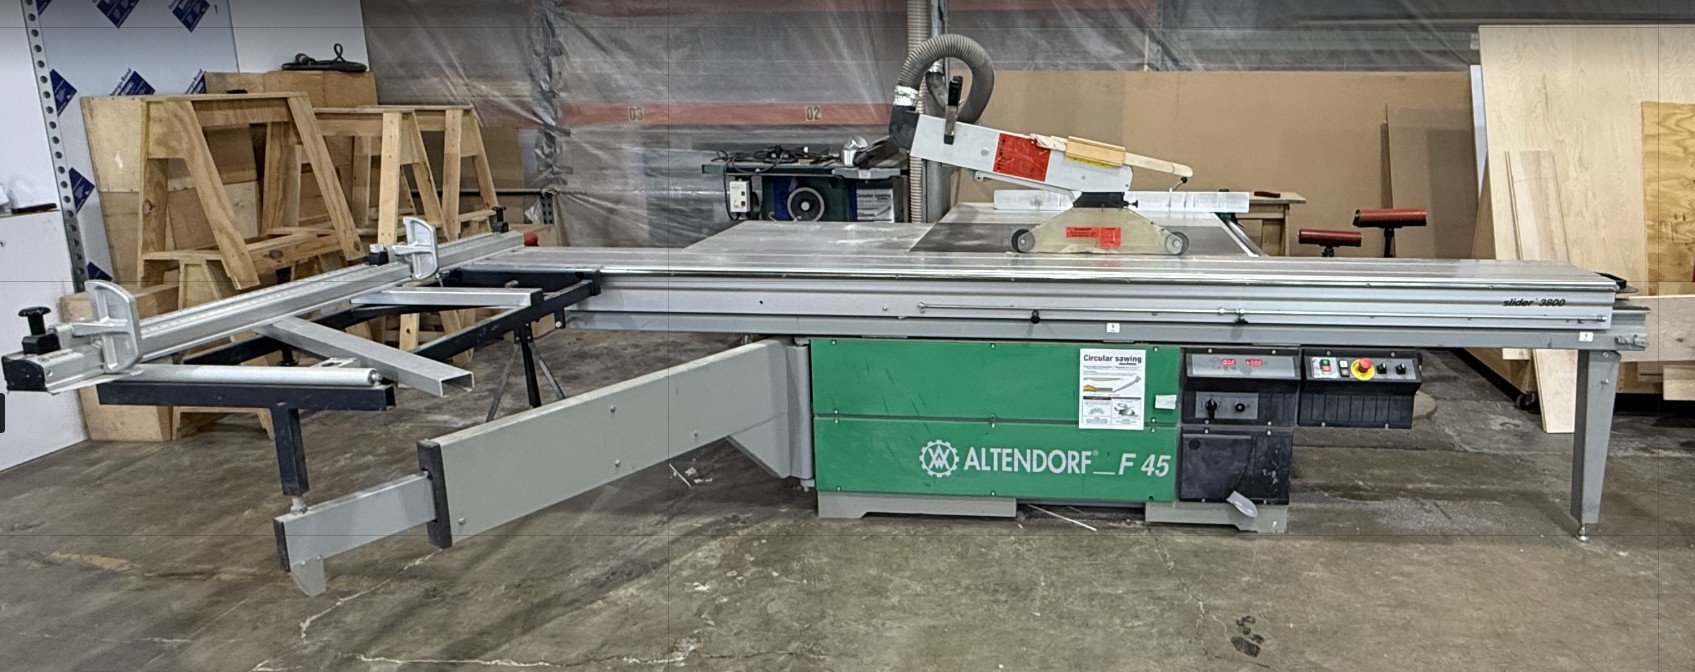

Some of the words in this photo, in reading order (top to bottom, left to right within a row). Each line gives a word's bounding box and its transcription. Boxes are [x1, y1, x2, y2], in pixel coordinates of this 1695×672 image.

[629, 107, 644, 121] 03
[806, 107, 821, 121] 02
[1538, 298, 1566, 306] 3800
[1083, 354, 1113, 362] Circular
[1115, 355, 1142, 364] sawing
[1140, 454, 1171, 477] 45
